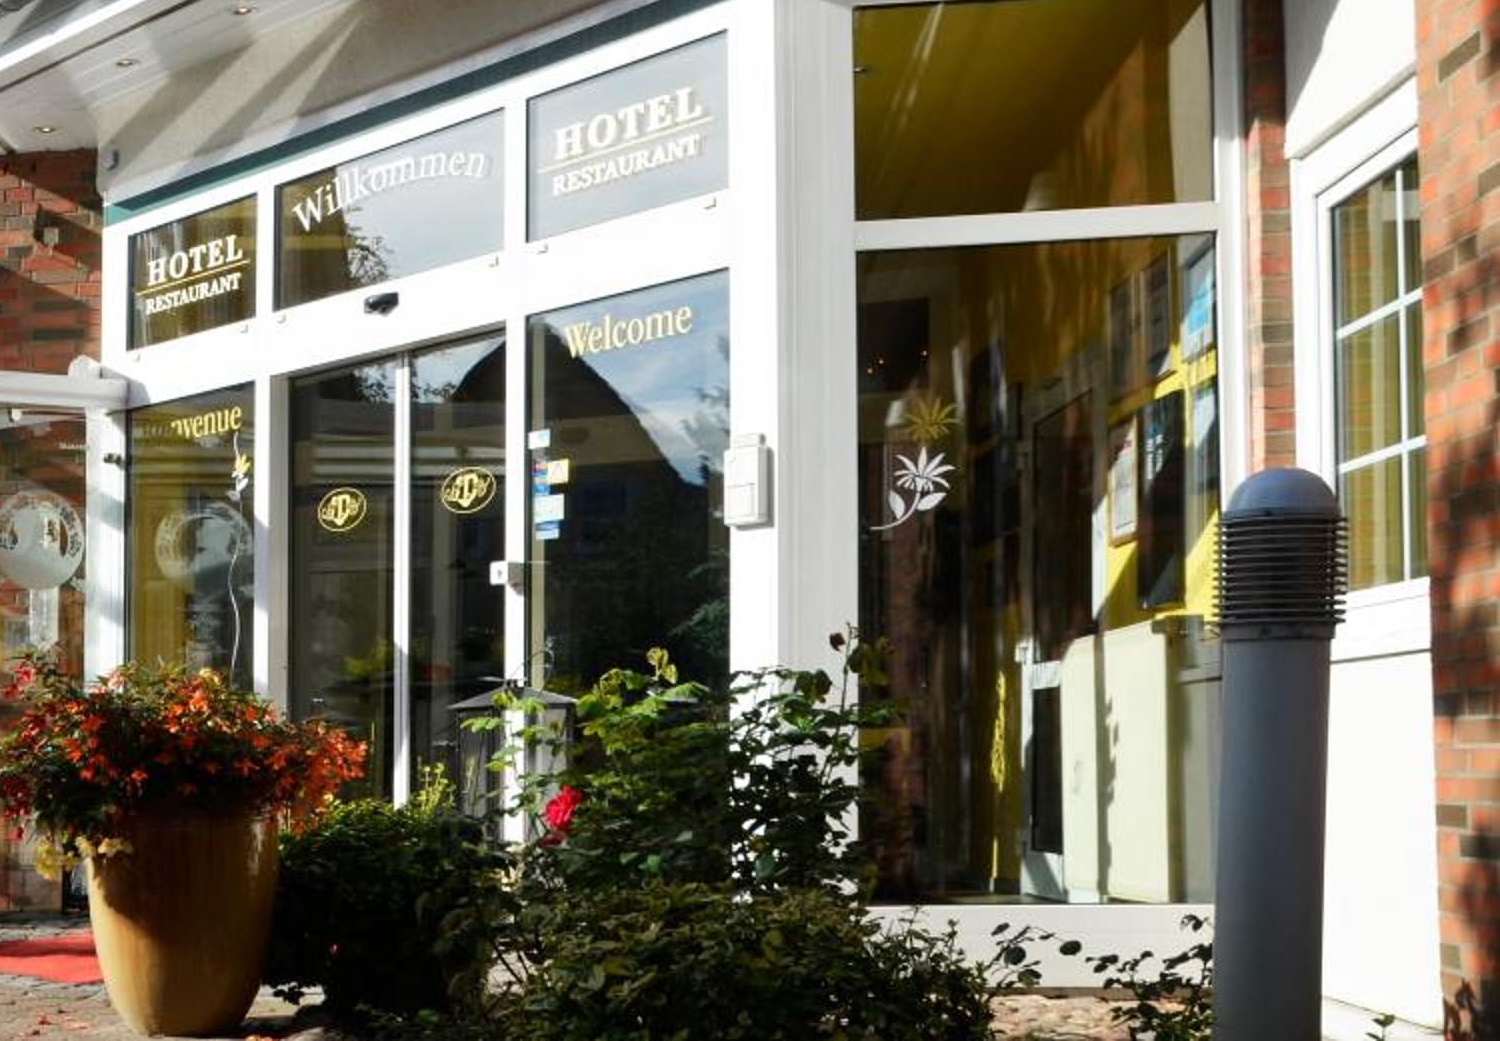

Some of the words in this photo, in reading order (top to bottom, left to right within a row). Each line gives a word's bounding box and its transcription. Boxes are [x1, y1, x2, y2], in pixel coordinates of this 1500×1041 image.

[555, 86, 703, 160] HOTEL
[293, 151, 485, 232] Willkommen
[552, 132, 701, 196] RESTAURANT
[147, 234, 243, 286] HOTEL
[145, 272, 242, 315] RESTAURANT
[564, 306, 693, 359] Welcome
